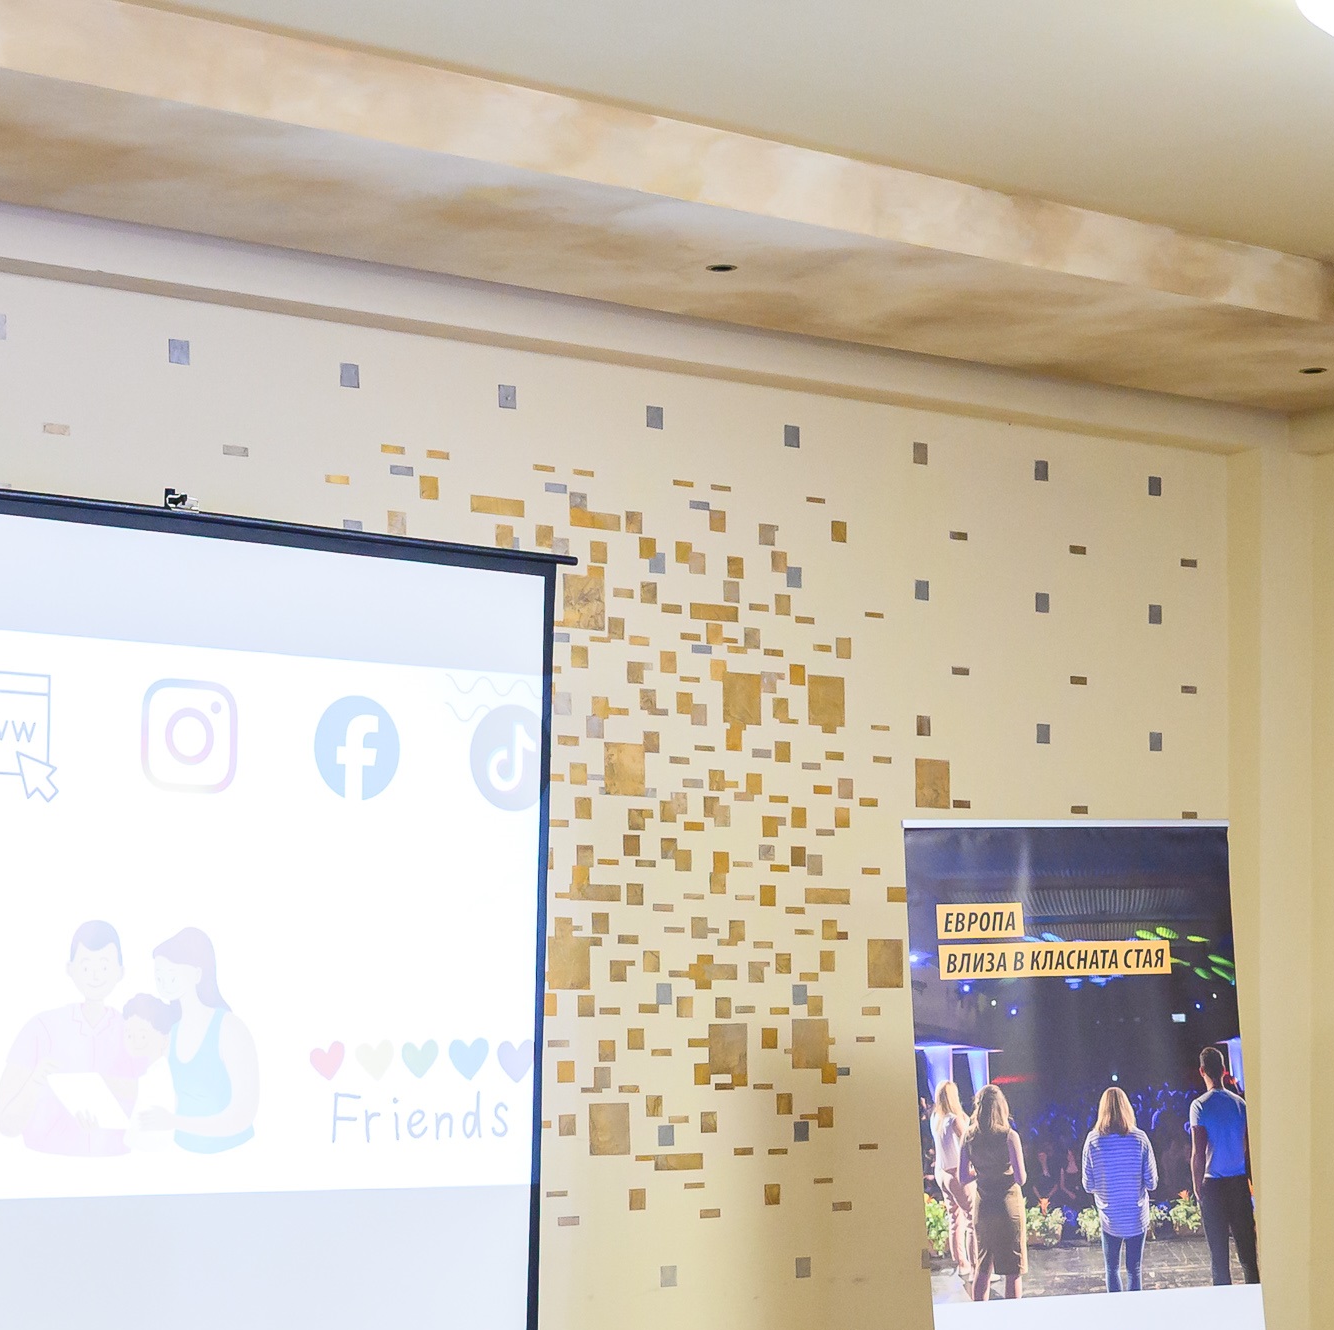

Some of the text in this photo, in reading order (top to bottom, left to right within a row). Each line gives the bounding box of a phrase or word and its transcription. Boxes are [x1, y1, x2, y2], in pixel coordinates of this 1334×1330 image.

[944, 911, 1016, 932] ЕВРОПА
[946, 948, 1165, 973] ВЛИЗА В КЛАСНАТА СТАЯ
[332, 1090, 508, 1143] Friends
